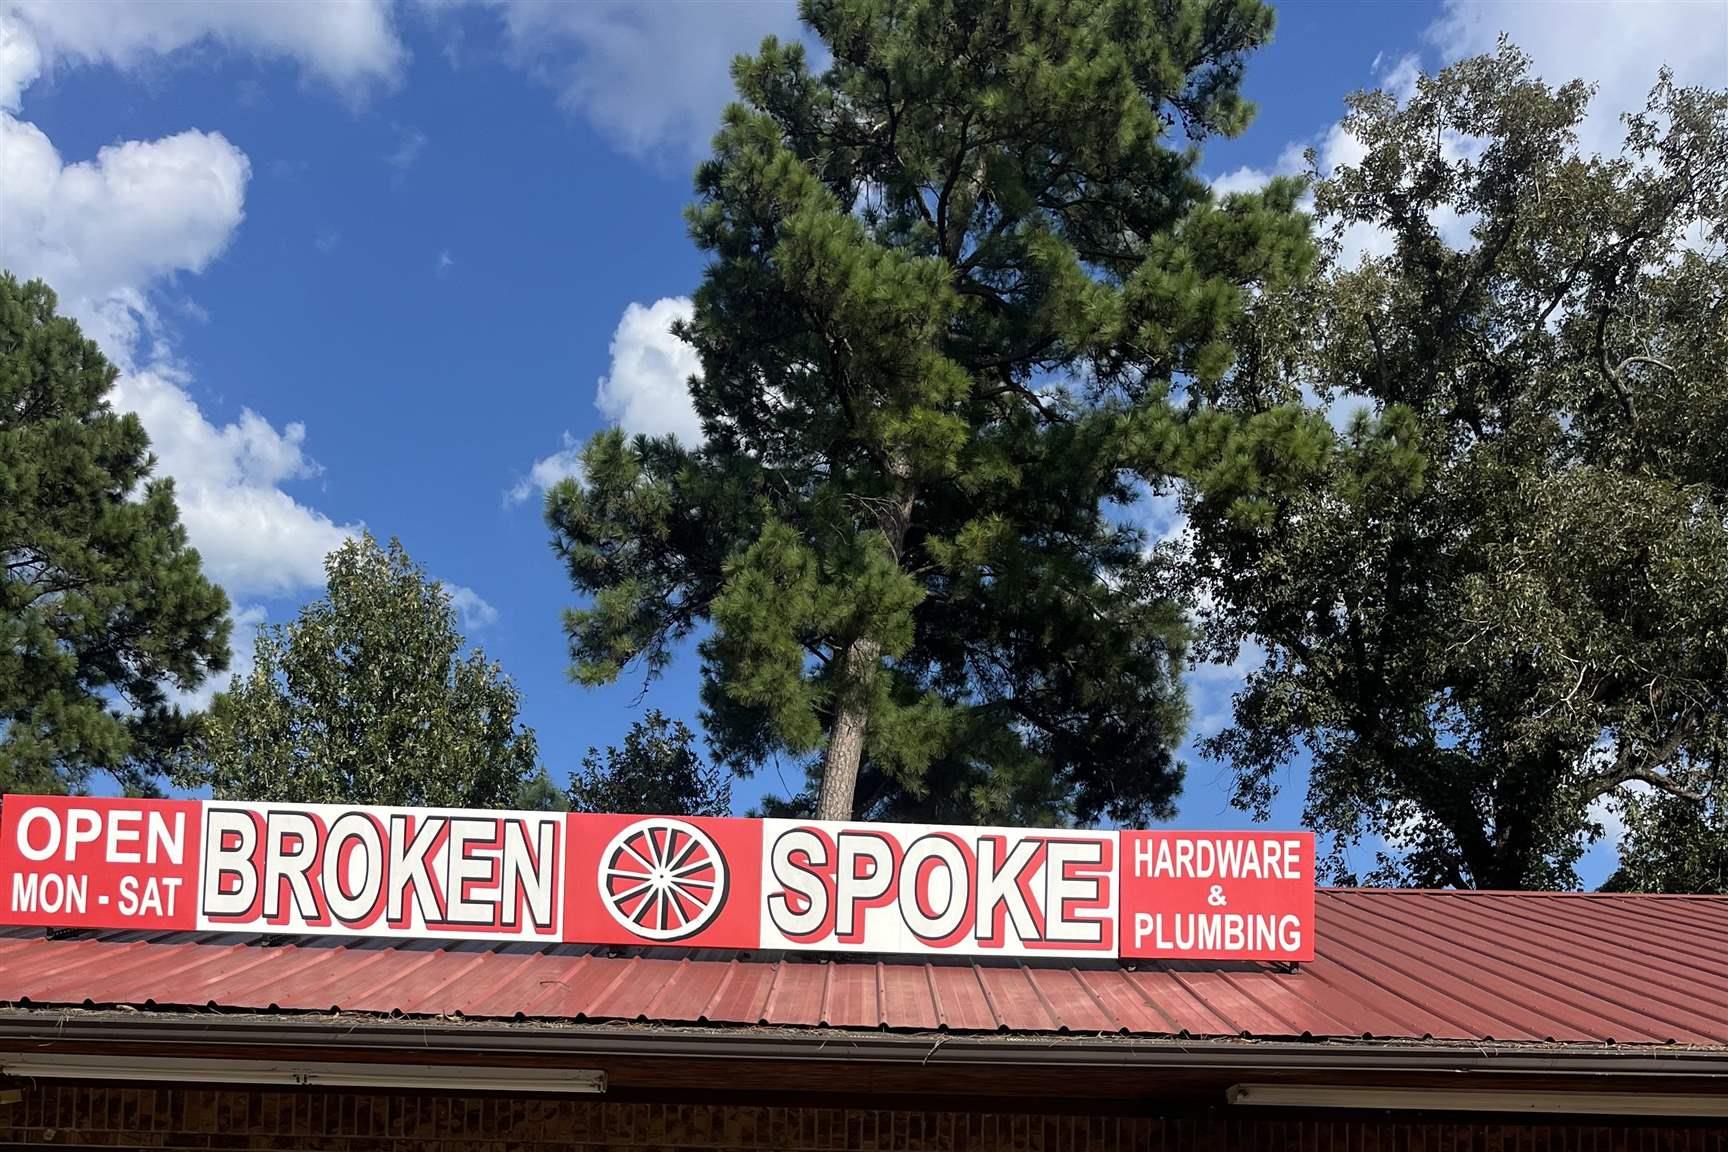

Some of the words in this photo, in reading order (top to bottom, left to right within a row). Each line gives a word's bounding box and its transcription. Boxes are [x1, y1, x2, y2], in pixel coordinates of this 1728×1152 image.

[16, 806, 184, 865] OPEN
[202, 808, 557, 930] BROKEN
[767, 827, 1113, 950] SPOKE
[1134, 839, 1300, 880] HARDWARE
[11, 872, 88, 912] MON
[117, 876, 183, 917] SAT
[1207, 884, 1227, 906] &
[1134, 913, 1301, 953] PLUMBING
